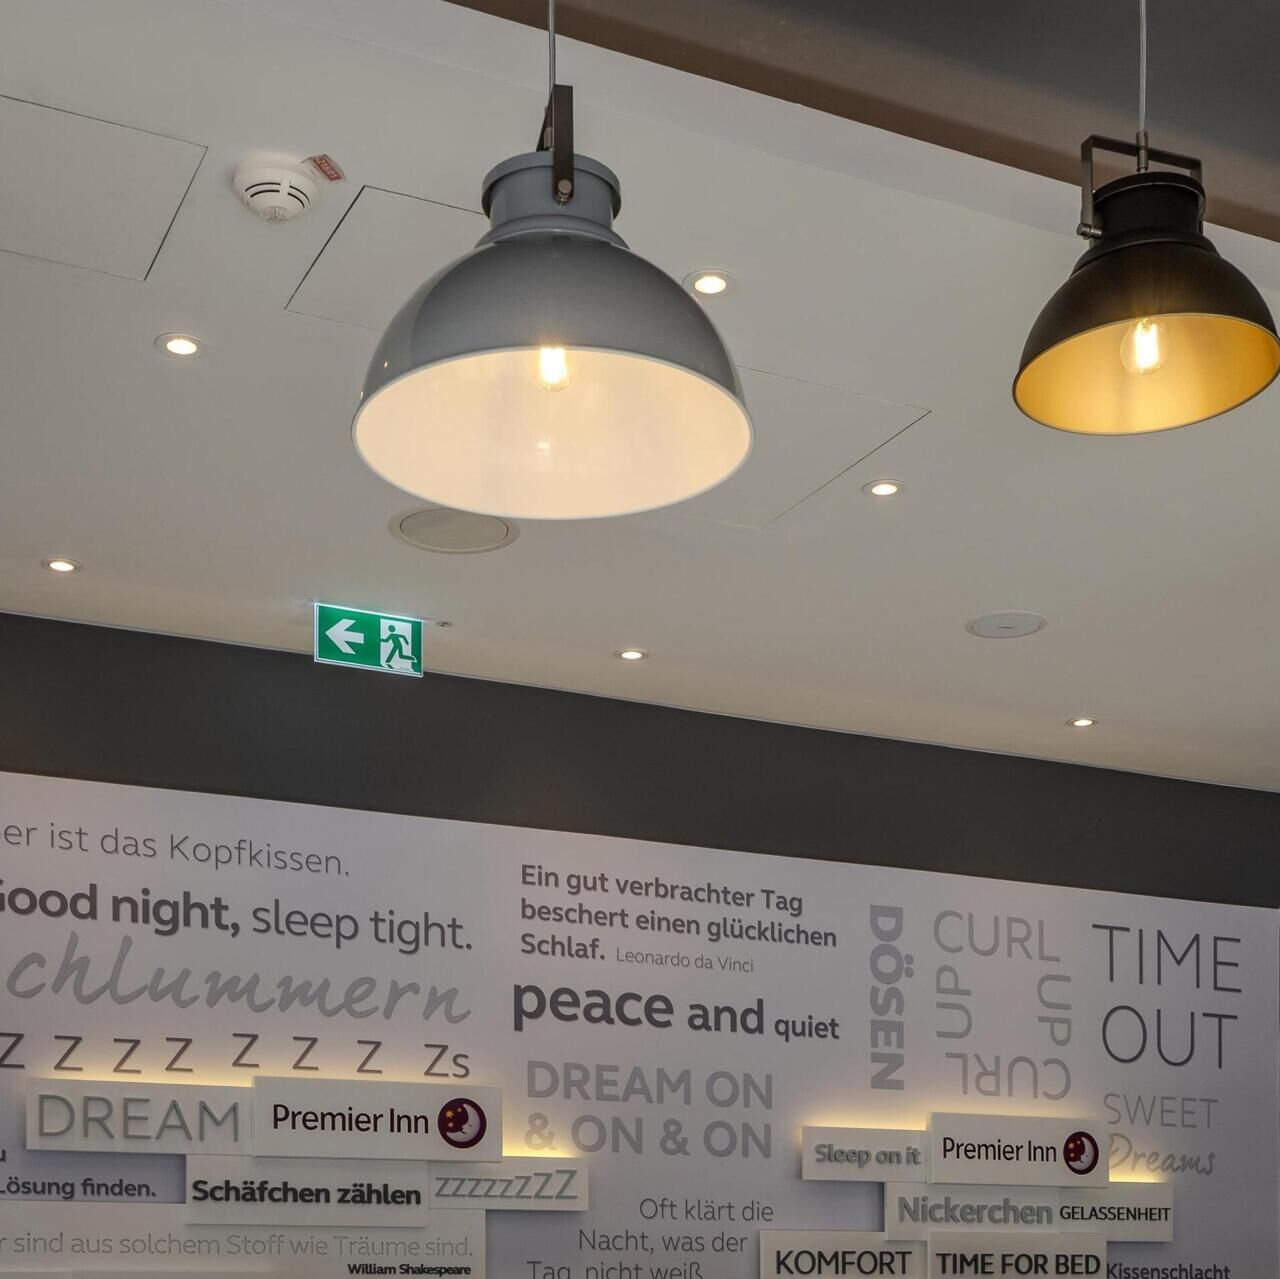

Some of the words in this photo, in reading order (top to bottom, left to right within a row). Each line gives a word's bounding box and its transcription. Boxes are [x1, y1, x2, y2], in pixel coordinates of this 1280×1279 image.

[49, 822, 89, 853] ist
[99, 827, 158, 859] das
[169, 833, 350, 877] Kopfkissen.
[521, 863, 560, 888] Ein
[566, 872, 610, 897] gut
[614, 875, 756, 909] verbrachter
[760, 888, 803, 918] Tag
[111, 887, 241, 939] night,
[251, 898, 360, 949] sleep
[368, 909, 473, 956] tight.
[520, 897, 630, 929] beschert
[635, 909, 701, 936] einen
[706, 912, 837, 950] glücklichen
[933, 909, 1061, 963] CURL
[520, 932, 606, 961] Schlaf.
[615, 946, 691, 969] Leonardo
[693, 953, 714, 970] da
[716, 955, 754, 974] Vinci
[1091, 923, 1243, 994] TIME
[513, 983, 675, 1033] peace
[687, 997, 765, 1035] and
[773, 1014, 840, 1043] quiet
[868, 904, 915, 1091] DÖSEN
[935, 964, 973, 1040] UP
[1036, 973, 1072, 1047] UP
[53, 1034, 84, 1072] Z
[112, 1037, 142, 1075] Z
[164, 1036, 194, 1074] Z
[231, 1032, 260, 1069] Z
[291, 1035, 320, 1072] Z
[356, 1039, 383, 1075] Z
[423, 1043, 471, 1079] Zs
[1101, 1004, 1239, 1070] OUT
[526, 1059, 692, 1106] DREAM
[705, 1070, 773, 1110] ON
[944, 1051, 1072, 1101] CURL
[37, 1093, 240, 1143] DREAM
[272, 1103, 381, 1133] Premier
[389, 1107, 429, 1135] Inn
[1103, 1091, 1219, 1129] SWEET
[524, 1111, 556, 1148] &
[571, 1114, 644, 1155] ON
[658, 1118, 691, 1157] &
[702, 1120, 772, 1159] ON
[814, 1143, 872, 1169] Sleep
[874, 1150, 903, 1166] on
[904, 1145, 922, 1167] it
[942, 1136, 1024, 1162] Premier
[1027, 1139, 1057, 1163] Inn
[1108, 1132, 1216, 1176] Dreams
[79, 1177, 157, 1198] finden.
[191, 1179, 331, 1204] Schäfchen
[336, 1182, 422, 1206] zählen
[639, 1197, 678, 1221] Oft
[684, 1198, 736, 1222] klärt
[741, 1199, 775, 1223] die
[897, 1195, 1054, 1225] Nickerchen
[1059, 1205, 1171, 1222] GELASSENHEIT
[13, 1231, 65, 1254] sind
[70, 1237, 114, 1254] aus
[118, 1232, 221, 1255] solchem
[225, 1233, 286, 1256] Stoff
[288, 1234, 329, 1256] wie
[332, 1235, 421, 1257] Träume
[424, 1236, 474, 1257] sind.
[578, 1228, 655, 1255] Nacht,
[661, 1235, 706, 1253] was
[711, 1230, 749, 1253] der
[775, 1249, 913, 1276] KOMFORT
[935, 1252, 995, 1276] TIME
[1000, 1253, 1049, 1276] FOR
[1054, 1253, 1102, 1276] BED
[346, 1263, 397, 1277] William
